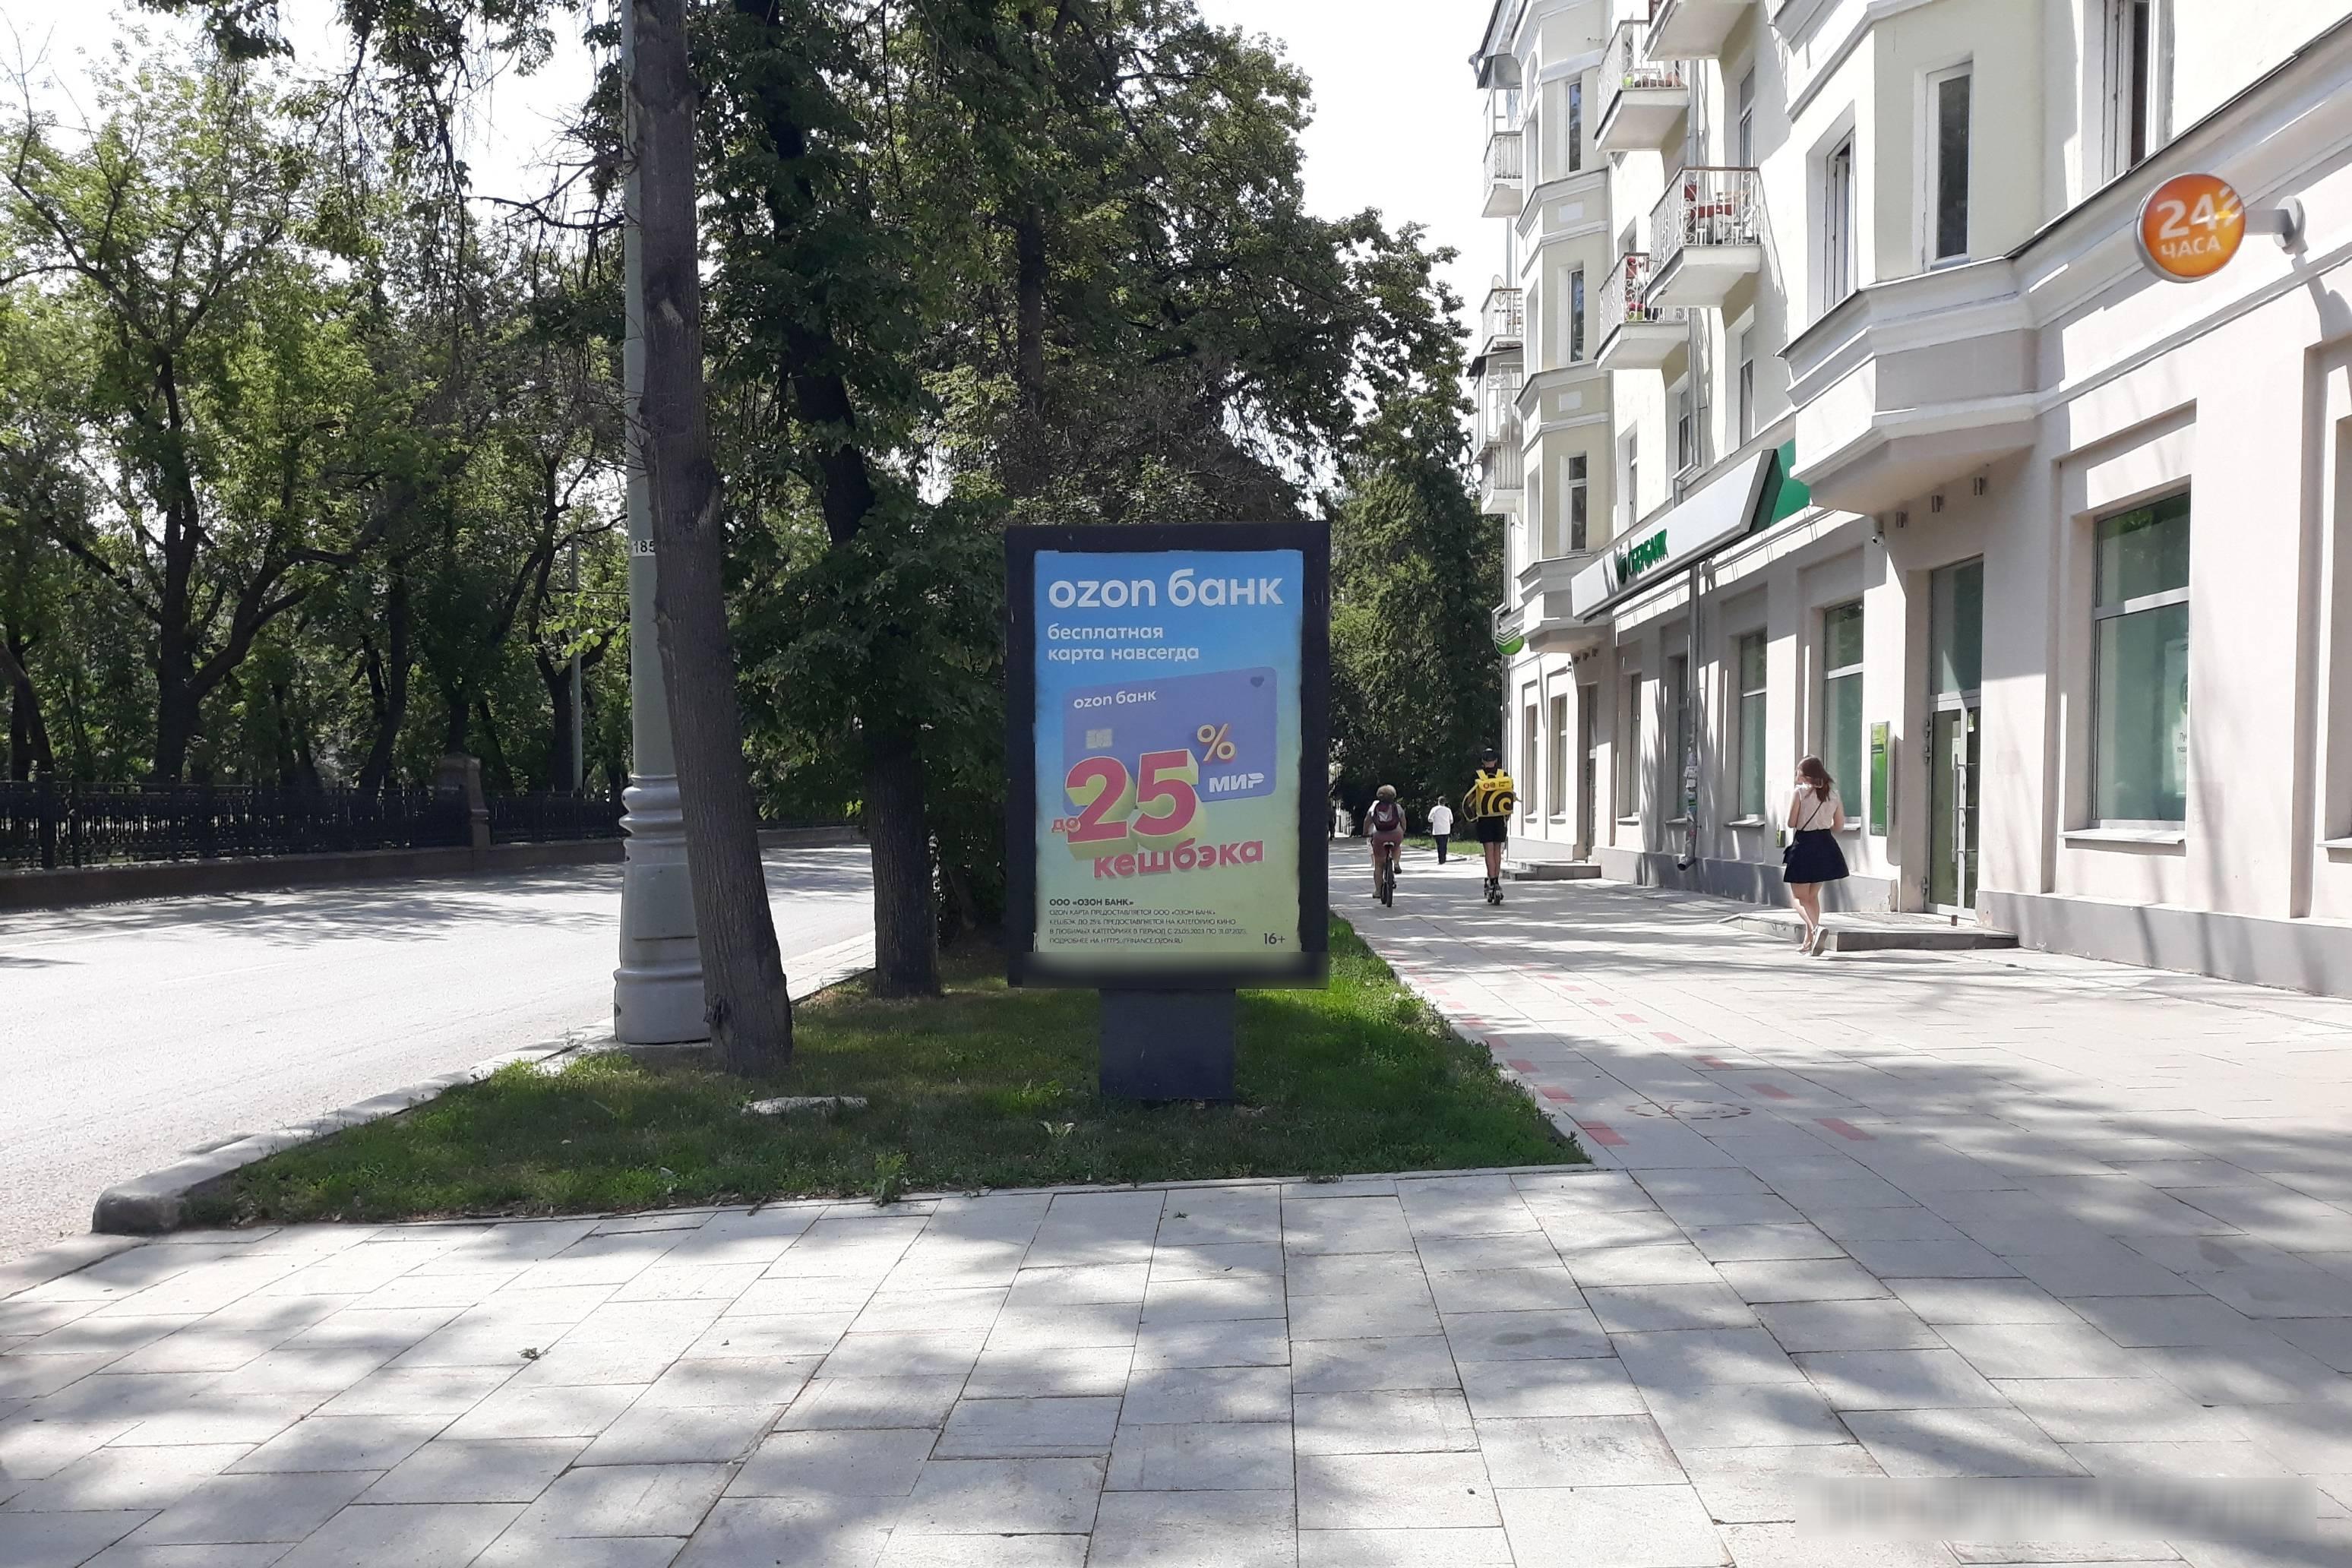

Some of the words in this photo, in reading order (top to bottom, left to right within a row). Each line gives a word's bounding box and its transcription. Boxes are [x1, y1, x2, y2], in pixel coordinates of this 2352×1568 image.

[2157, 194, 2218, 240] 24
[2160, 236, 2221, 259] ЧАСА
[1048, 578, 1156, 609] ozon
[1168, 568, 1284, 607] банк
[1048, 623, 1164, 640] бесплатная
[1048, 648, 1105, 665] карта
[1111, 646, 1200, 662] навсегда
[1073, 694, 1112, 709] ozon
[1116, 690, 1157, 706] банк
[1209, 772, 1265, 793] МИР
[1051, 817, 1081, 833] до
[1094, 837, 1264, 879] кешбэка
[1263, 932, 1286, 945] 16+
